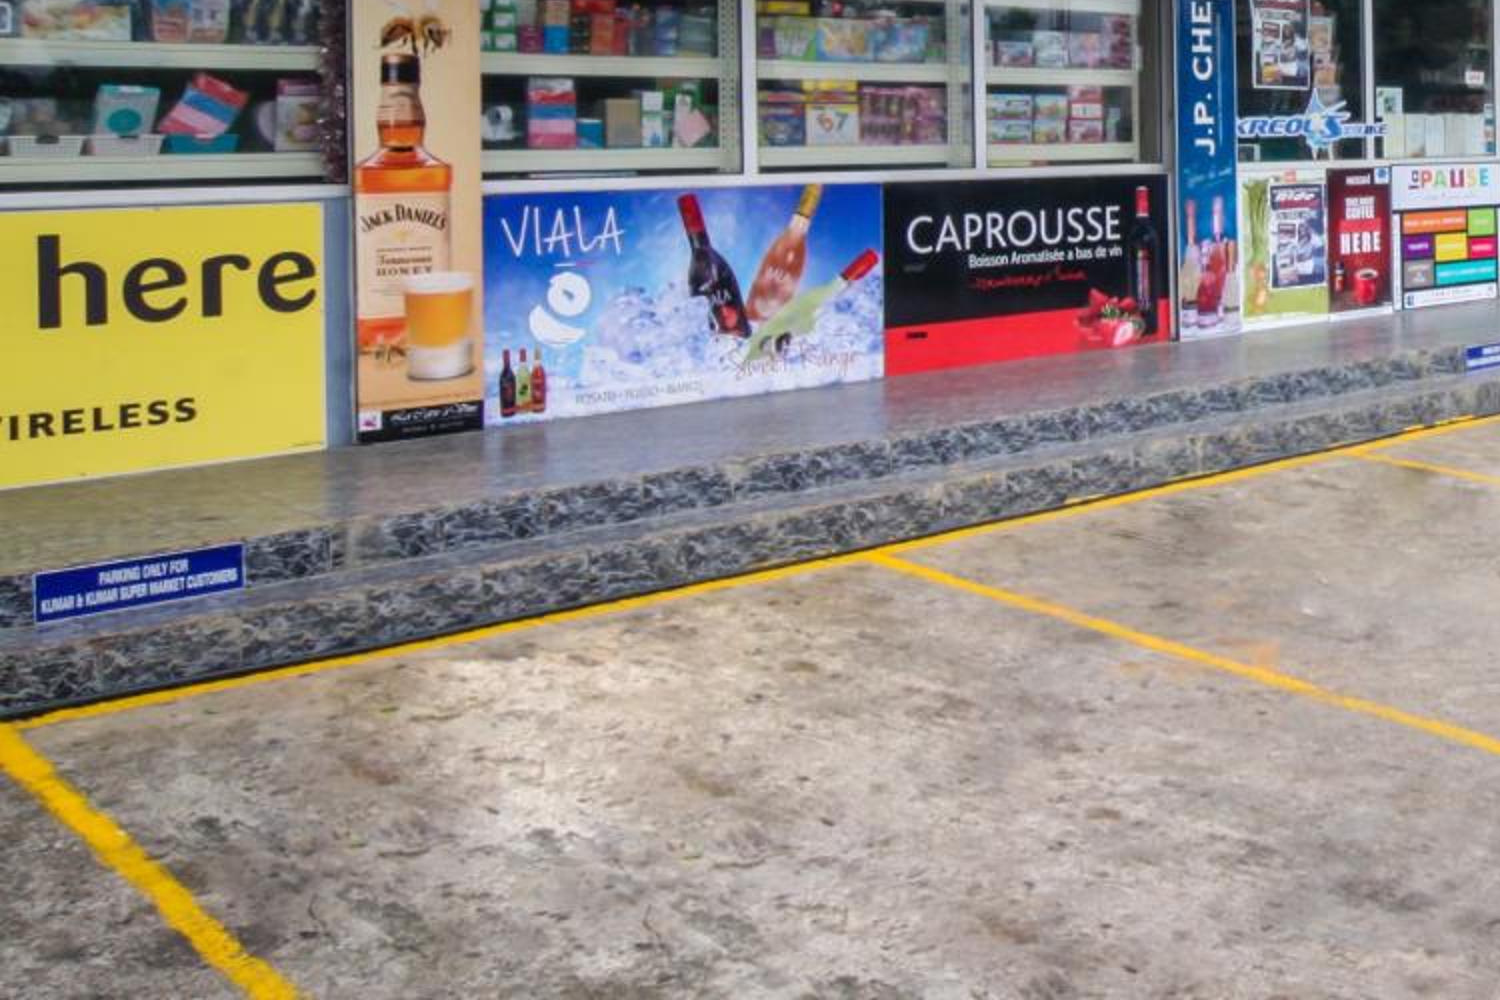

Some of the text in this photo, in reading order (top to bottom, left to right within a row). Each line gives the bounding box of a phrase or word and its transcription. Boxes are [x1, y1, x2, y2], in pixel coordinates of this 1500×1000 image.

[1193, 92, 1216, 157] J.P.
[1420, 166, 1490, 189] PAUSE
[360, 209, 393, 233] JACK
[500, 204, 625, 258] VIALA
[907, 206, 1121, 255] CAPROUSSE
[968, 253, 1009, 269] Boisson
[1010, 250, 1065, 265] Aromatisée
[1075, 247, 1093, 260] bas
[1095, 246, 1107, 258] de
[1109, 245, 1123, 257] vin
[1340, 231, 1382, 255] HERE
[37, 234, 317, 329] here
[0, 398, 197, 441] IRELESS
[98, 558, 189, 586] PARKING ONLY FOR
[41, 595, 75, 613] KUMAR
[85, 588, 118, 606] KUMAR
[120, 584, 147, 601] SUPER
[149, 577, 186, 597] MARKET
